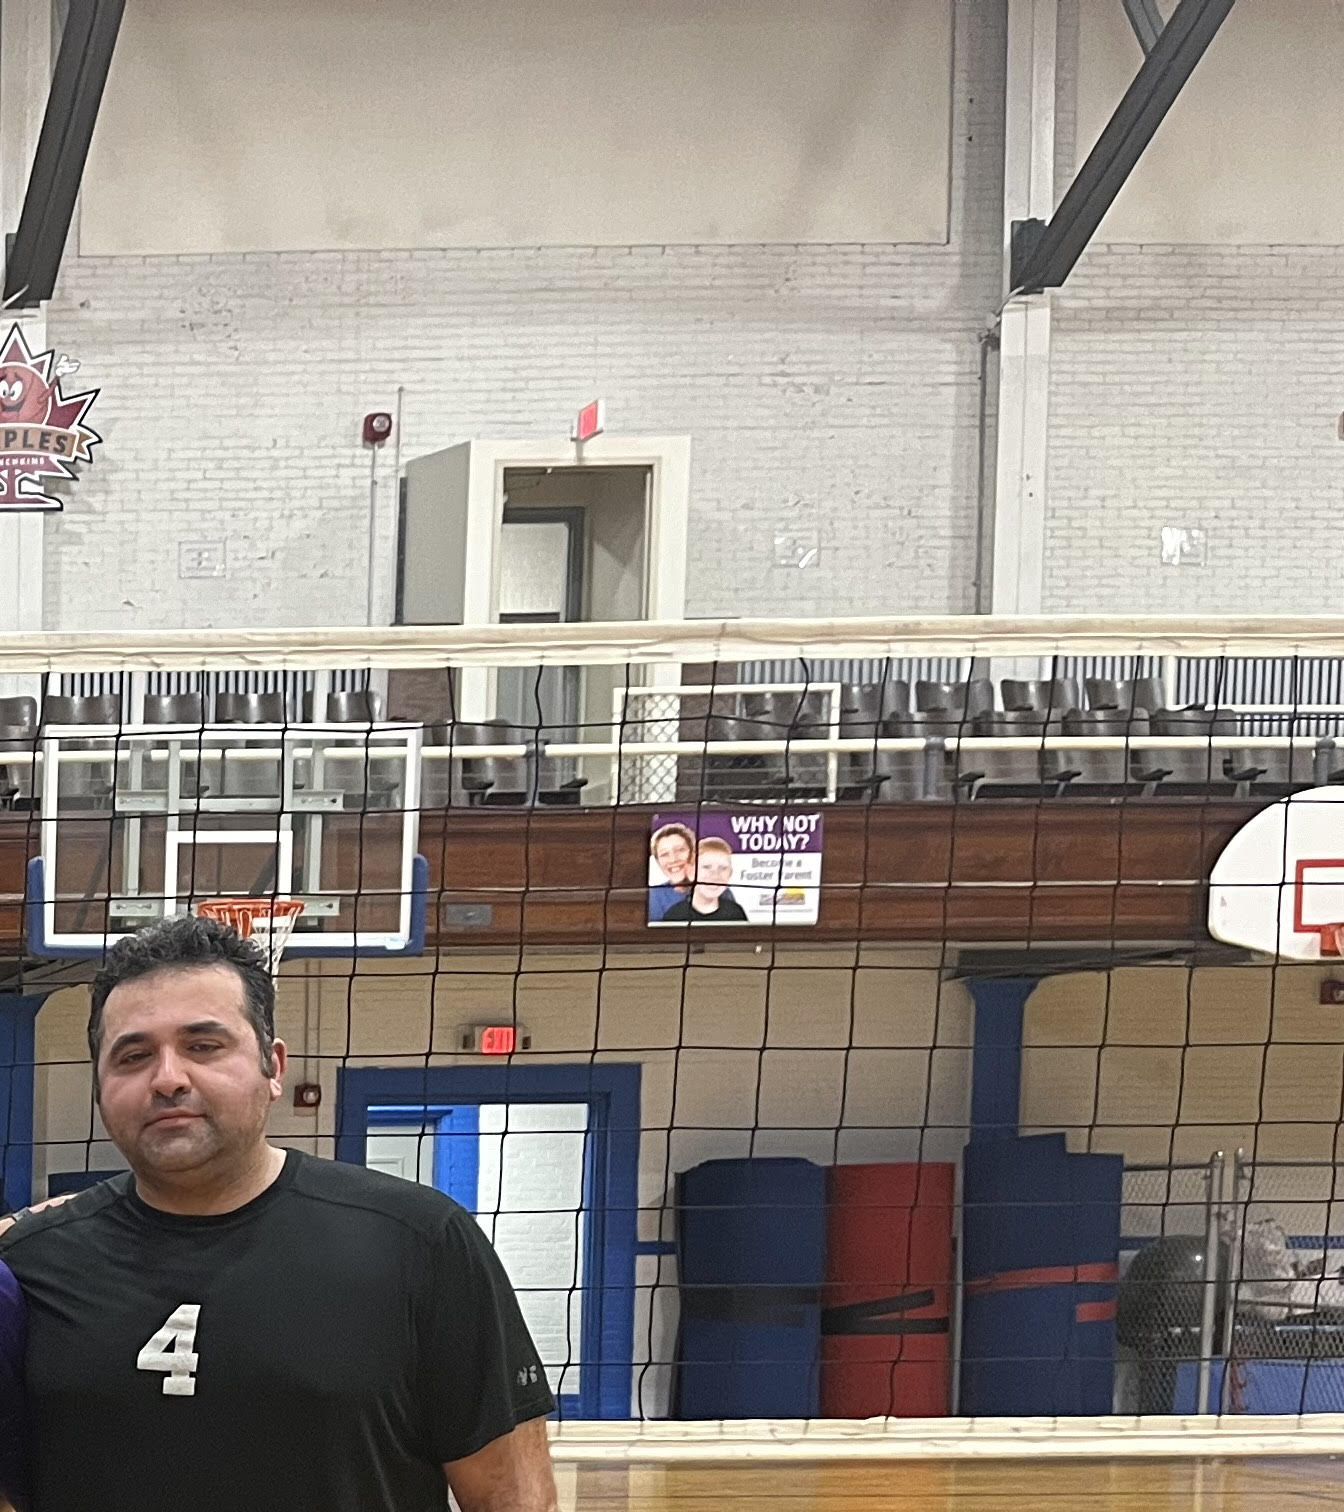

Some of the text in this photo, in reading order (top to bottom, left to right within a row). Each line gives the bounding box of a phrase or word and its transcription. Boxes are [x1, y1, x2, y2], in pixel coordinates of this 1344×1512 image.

[731, 814, 820, 833] WHY NOT
[738, 833, 810, 851] TODAY?
[779, 870, 813, 880] arent
[137, 1304, 201, 1396] 4
